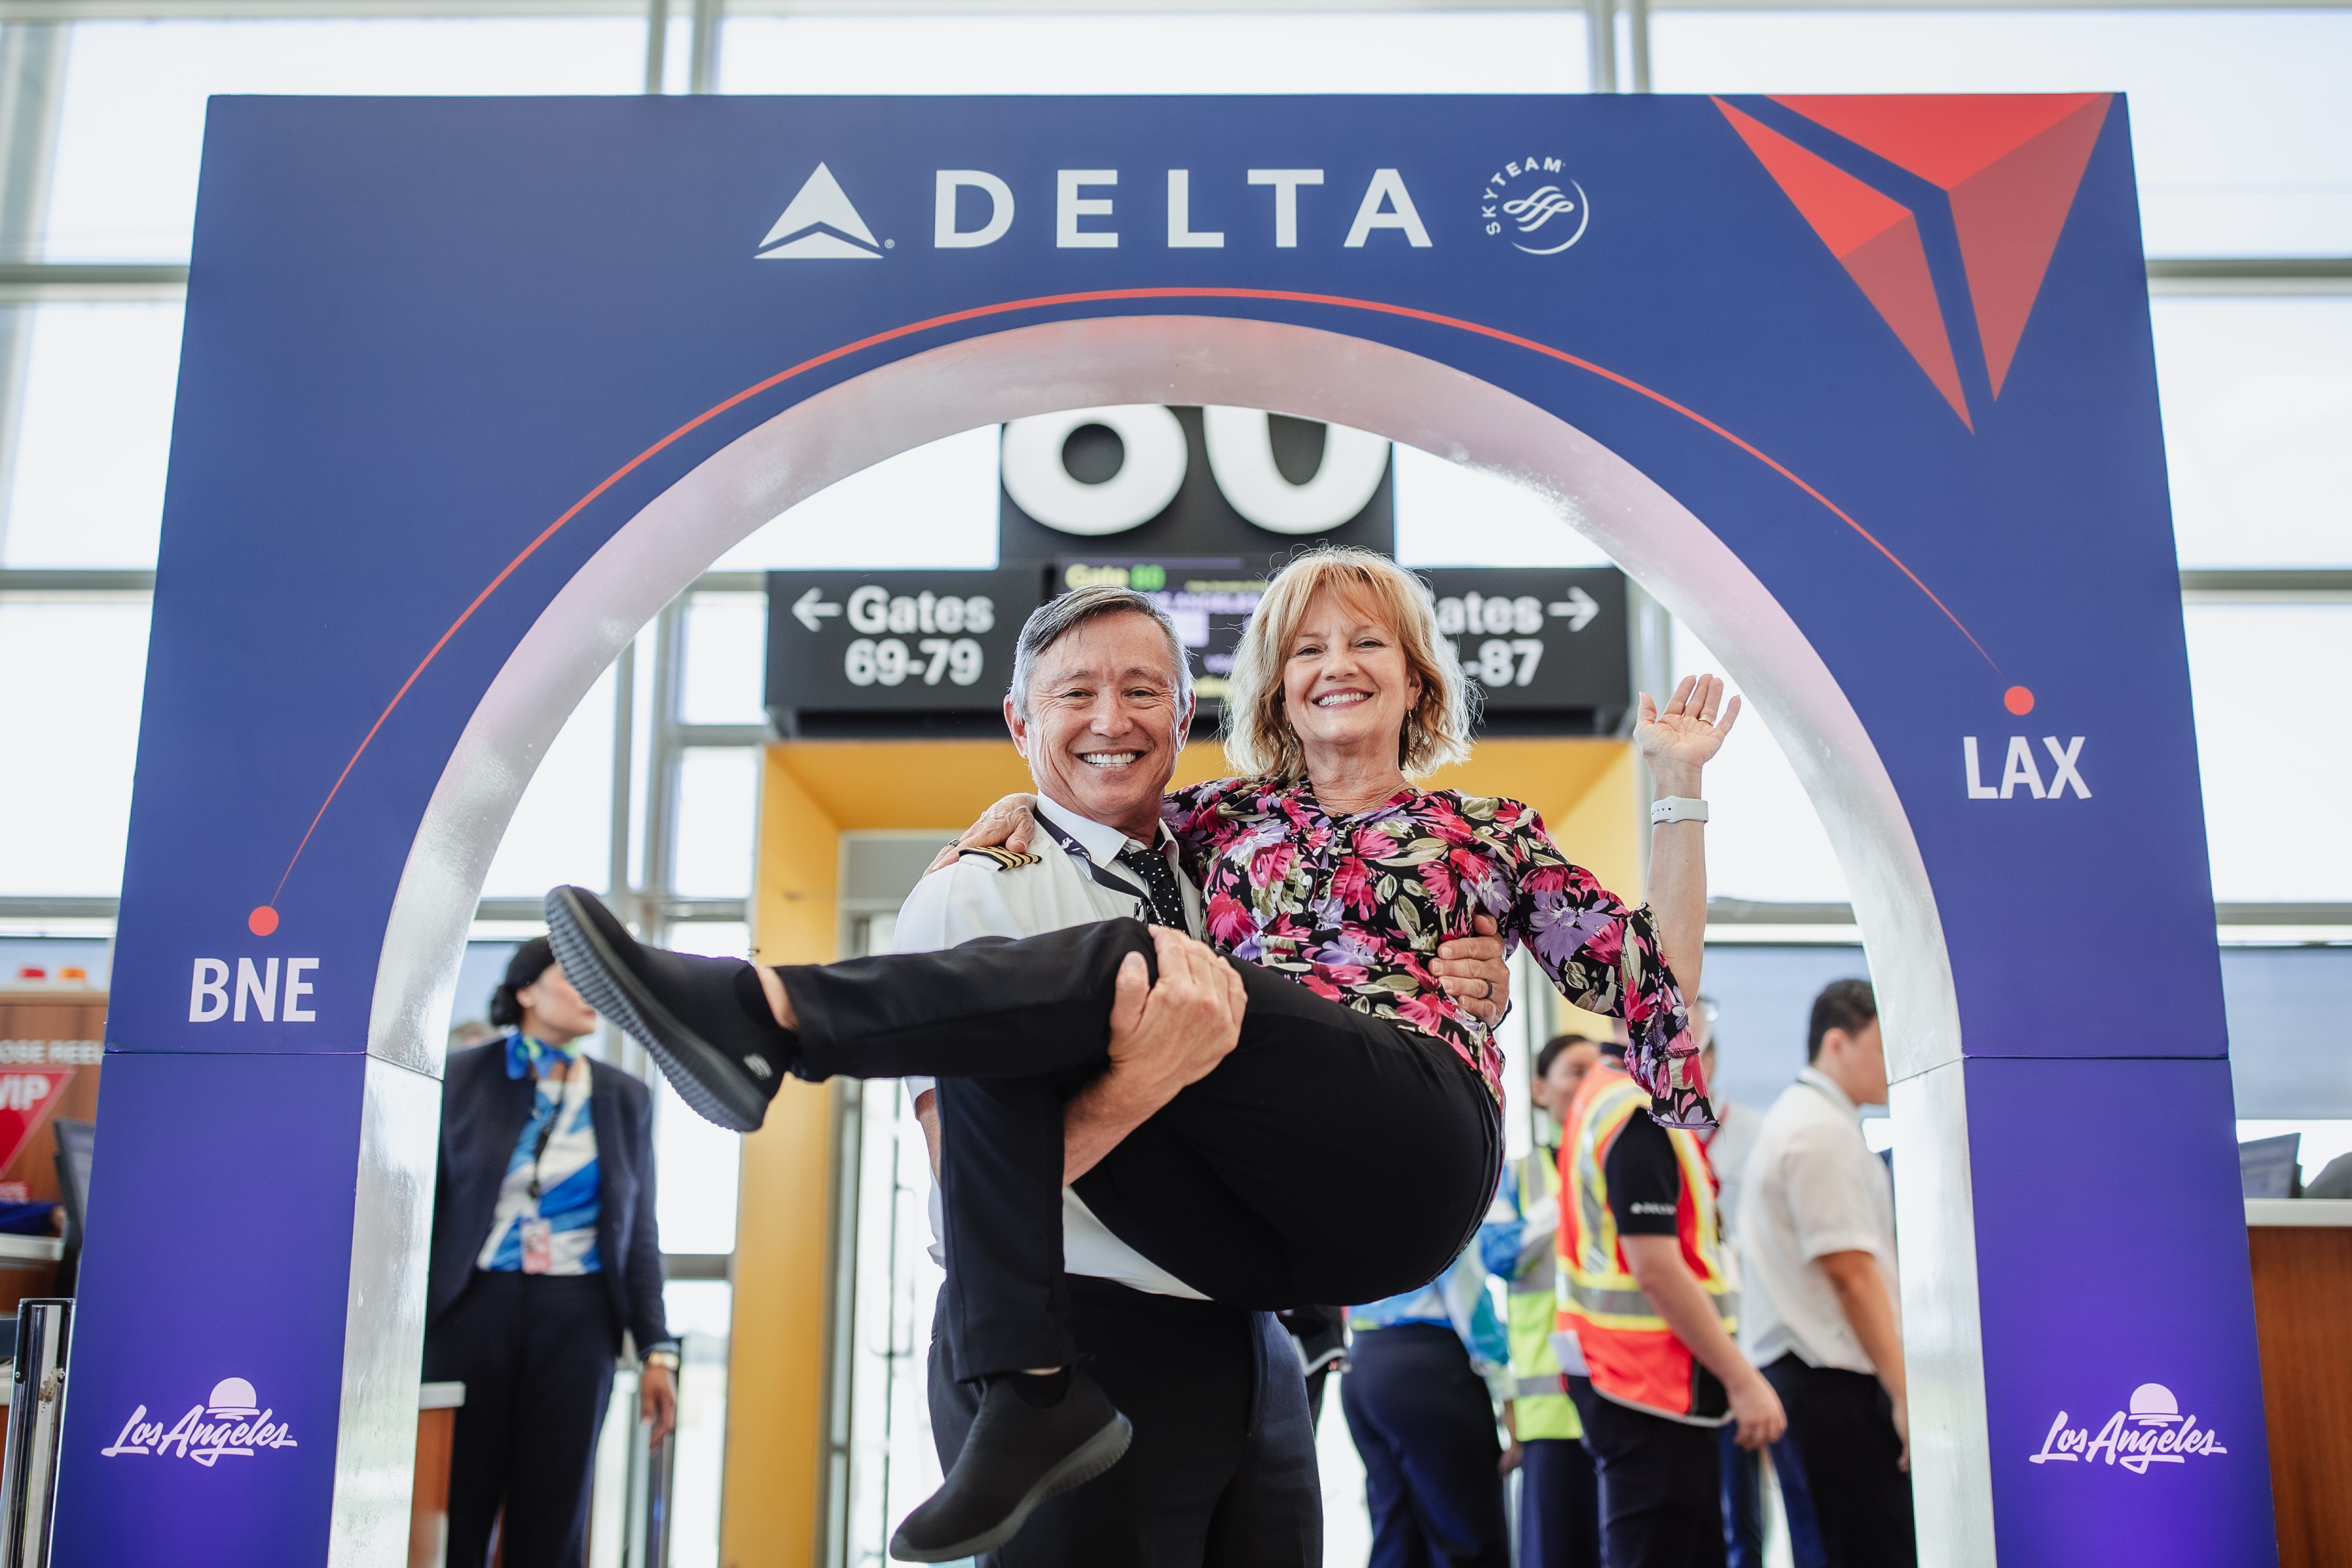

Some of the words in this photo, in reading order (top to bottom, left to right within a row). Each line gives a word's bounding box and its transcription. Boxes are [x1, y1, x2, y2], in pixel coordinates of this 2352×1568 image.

[934, 169, 1433, 248] DELTA
[1482, 156, 1562, 236] SKYTEAM
[847, 585, 994, 633] Gates
[1435, 591, 1544, 635] ates
[845, 638, 983, 686] 69-79
[1449, 639, 1544, 688] -87
[1963, 736, 2092, 799] LAX
[189, 957, 320, 1022] BNE
[101, 1404, 164, 1457] Los
[156, 1404, 297, 1467] Angeles
[2029, 1411, 2088, 1464] Los
[2085, 1411, 2227, 1474] Angeles
